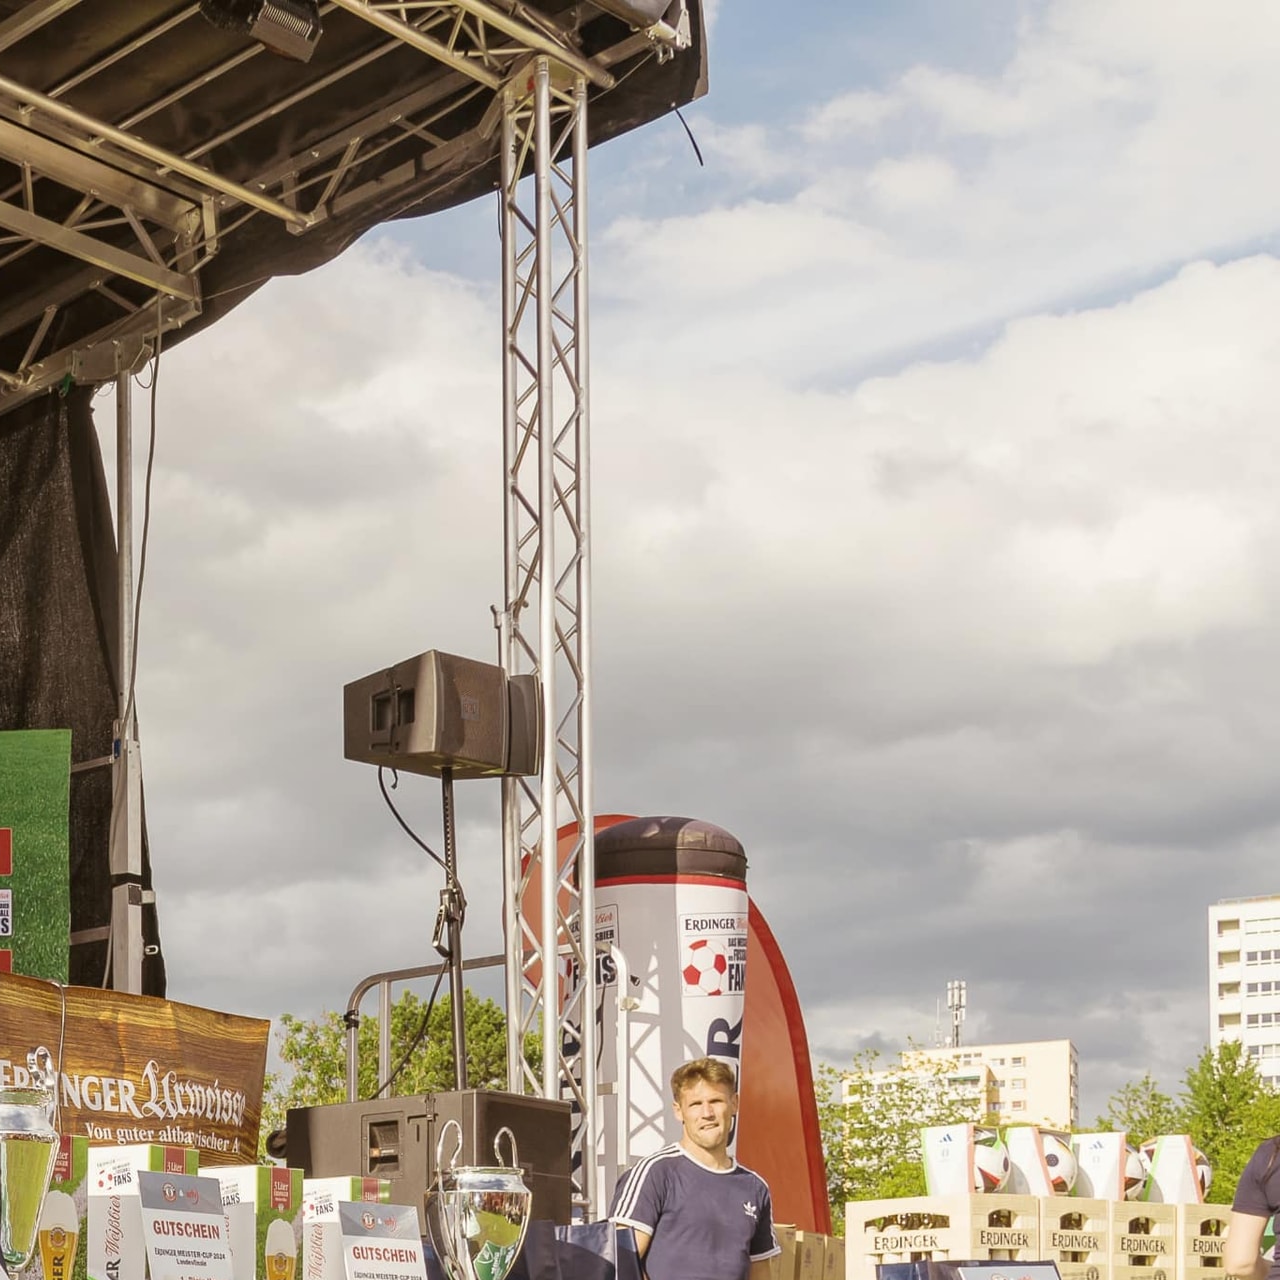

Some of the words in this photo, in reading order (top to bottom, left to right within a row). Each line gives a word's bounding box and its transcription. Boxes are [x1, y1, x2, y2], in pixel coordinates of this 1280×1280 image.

[685, 918, 736, 932] ERDINGER
[85, 1122, 112, 1140] Von
[117, 1126, 154, 1145] guter
[114, 1172, 132, 1186] FANS
[315, 1202, 334, 1216] FANS
[153, 1220, 220, 1240] GUTSCHEIN
[874, 1234, 939, 1251] ERDINGER
[980, 1230, 1029, 1248] ERDINGER
[1052, 1233, 1099, 1250] ERDINGER
[1121, 1237, 1167, 1254] ERDINGER
[352, 1246, 418, 1263] GUTSCHEIN
